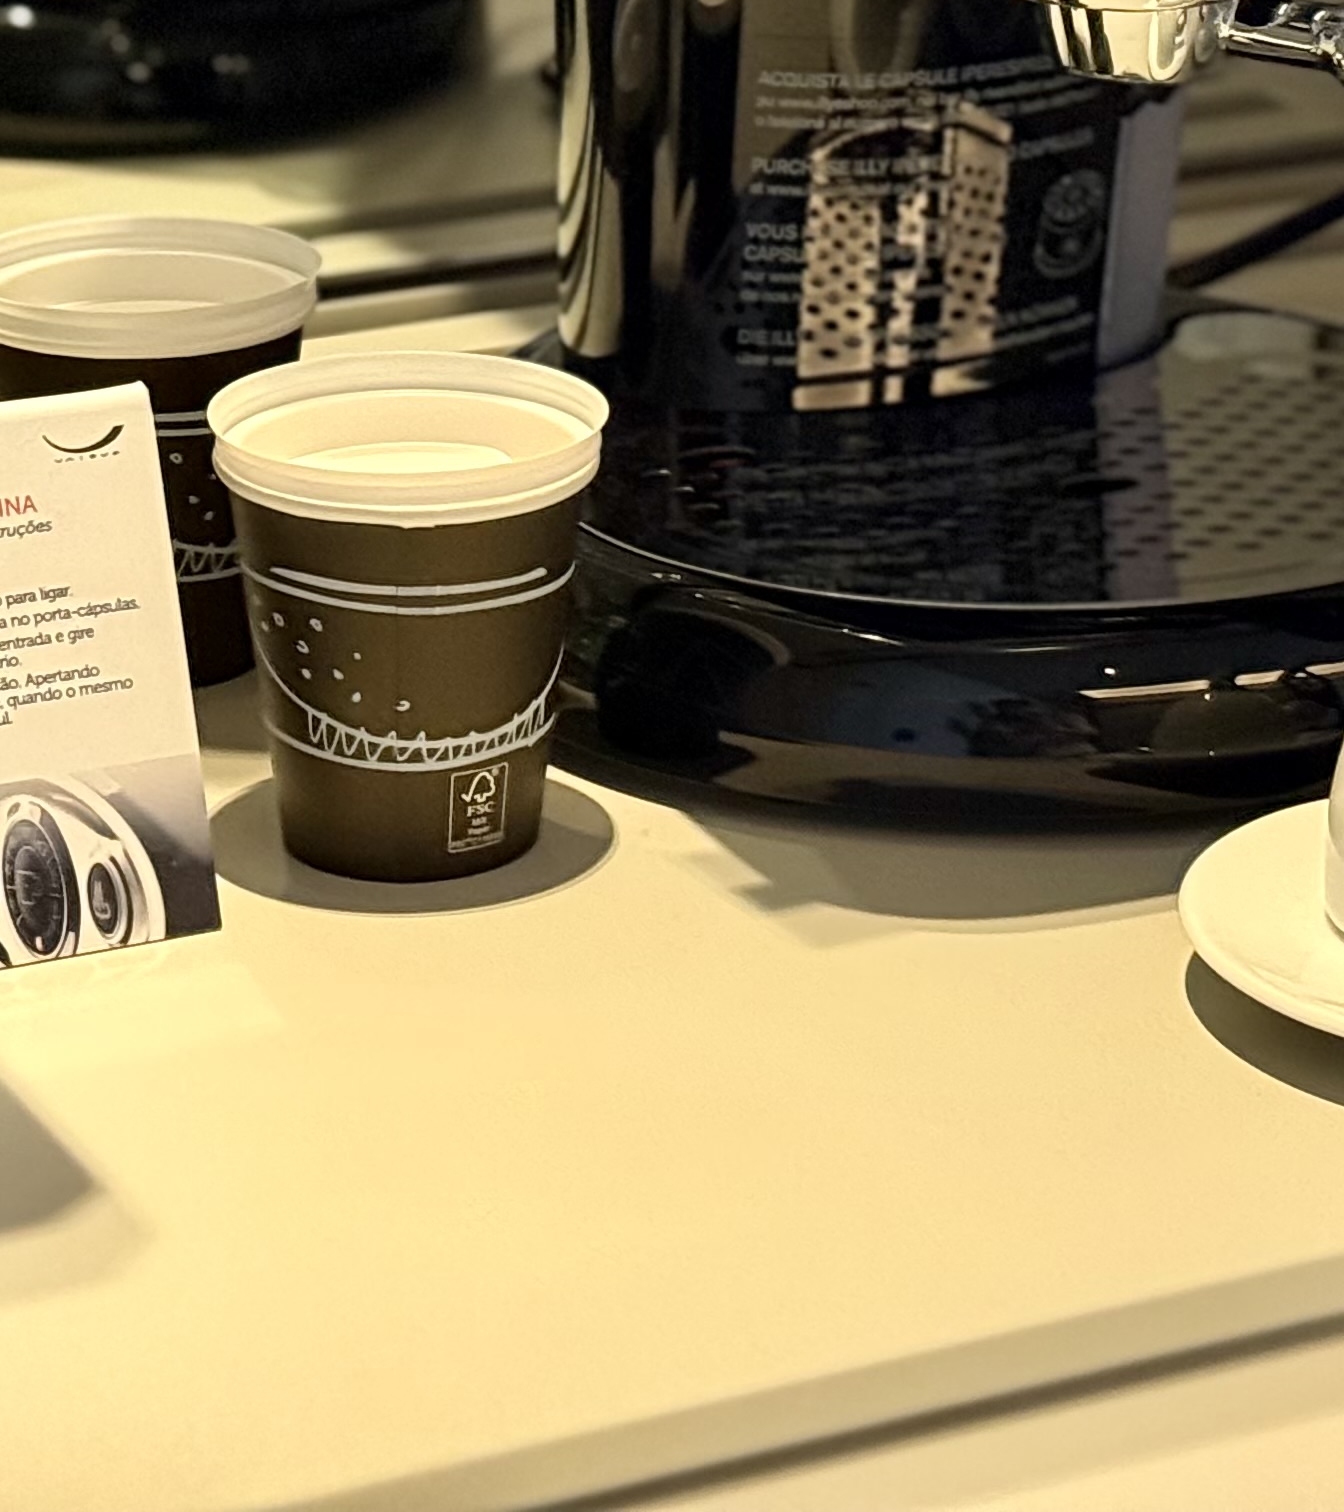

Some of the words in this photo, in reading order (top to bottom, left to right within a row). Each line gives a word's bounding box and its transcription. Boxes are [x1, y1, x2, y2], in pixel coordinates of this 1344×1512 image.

[6, 592, 37, 609] para
[10, 613, 31, 627] no
[55, 631, 65, 643] e
[67, 626, 95, 645] gire
[25, 664, 101, 688] Apertando
[6, 688, 63, 710] quando
[66, 687, 77, 699] o
[79, 676, 134, 696] mesmo
[467, 800, 495, 817] FSC
